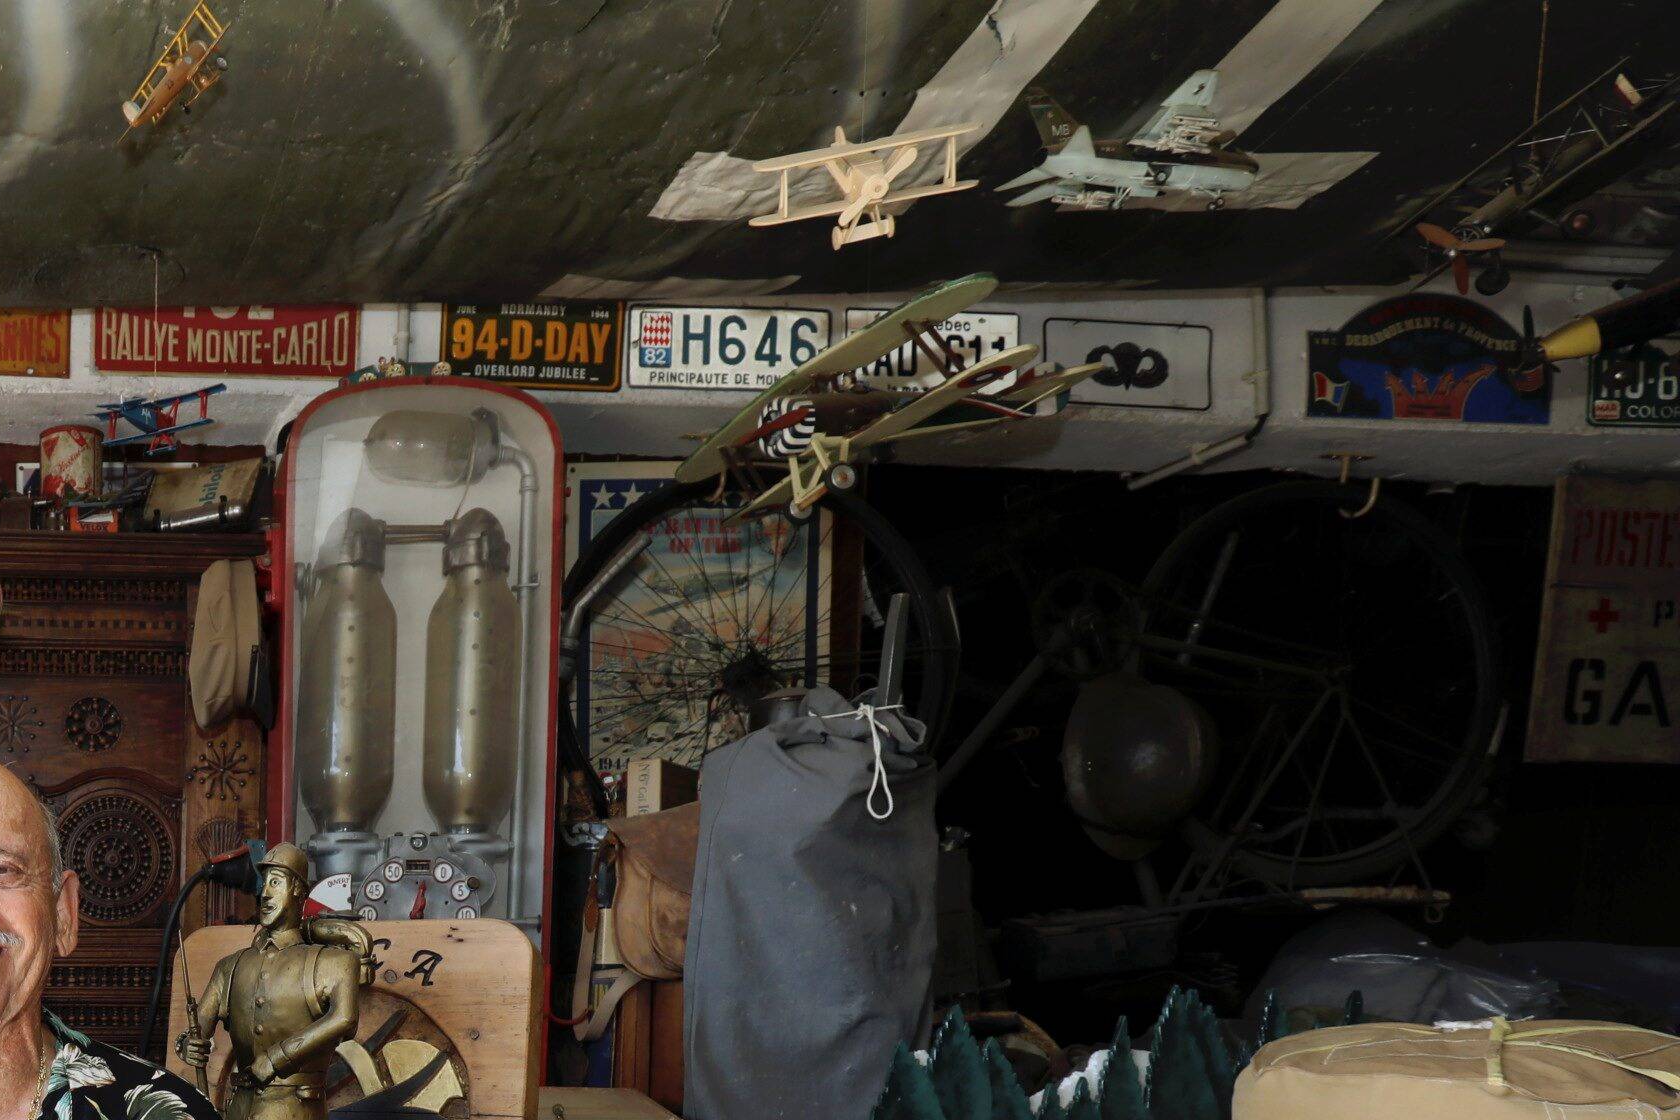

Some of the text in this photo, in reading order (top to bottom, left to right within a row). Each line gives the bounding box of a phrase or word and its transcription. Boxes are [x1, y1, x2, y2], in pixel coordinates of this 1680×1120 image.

[456, 305, 477, 315] JUNE
[500, 303, 567, 317] NORMANDY
[101, 307, 350, 367] RALLYE MONTE-CARLO
[681, 314, 819, 368] H646
[643, 348, 668, 365] 82
[474, 364, 587, 380] OVERLORD JUBILEE
[649, 371, 728, 386] PRINCIPAUTE
[734, 372, 749, 385] DE
[78, 519, 111, 533] VELOX
[326, 876, 351, 889] OUVERT
